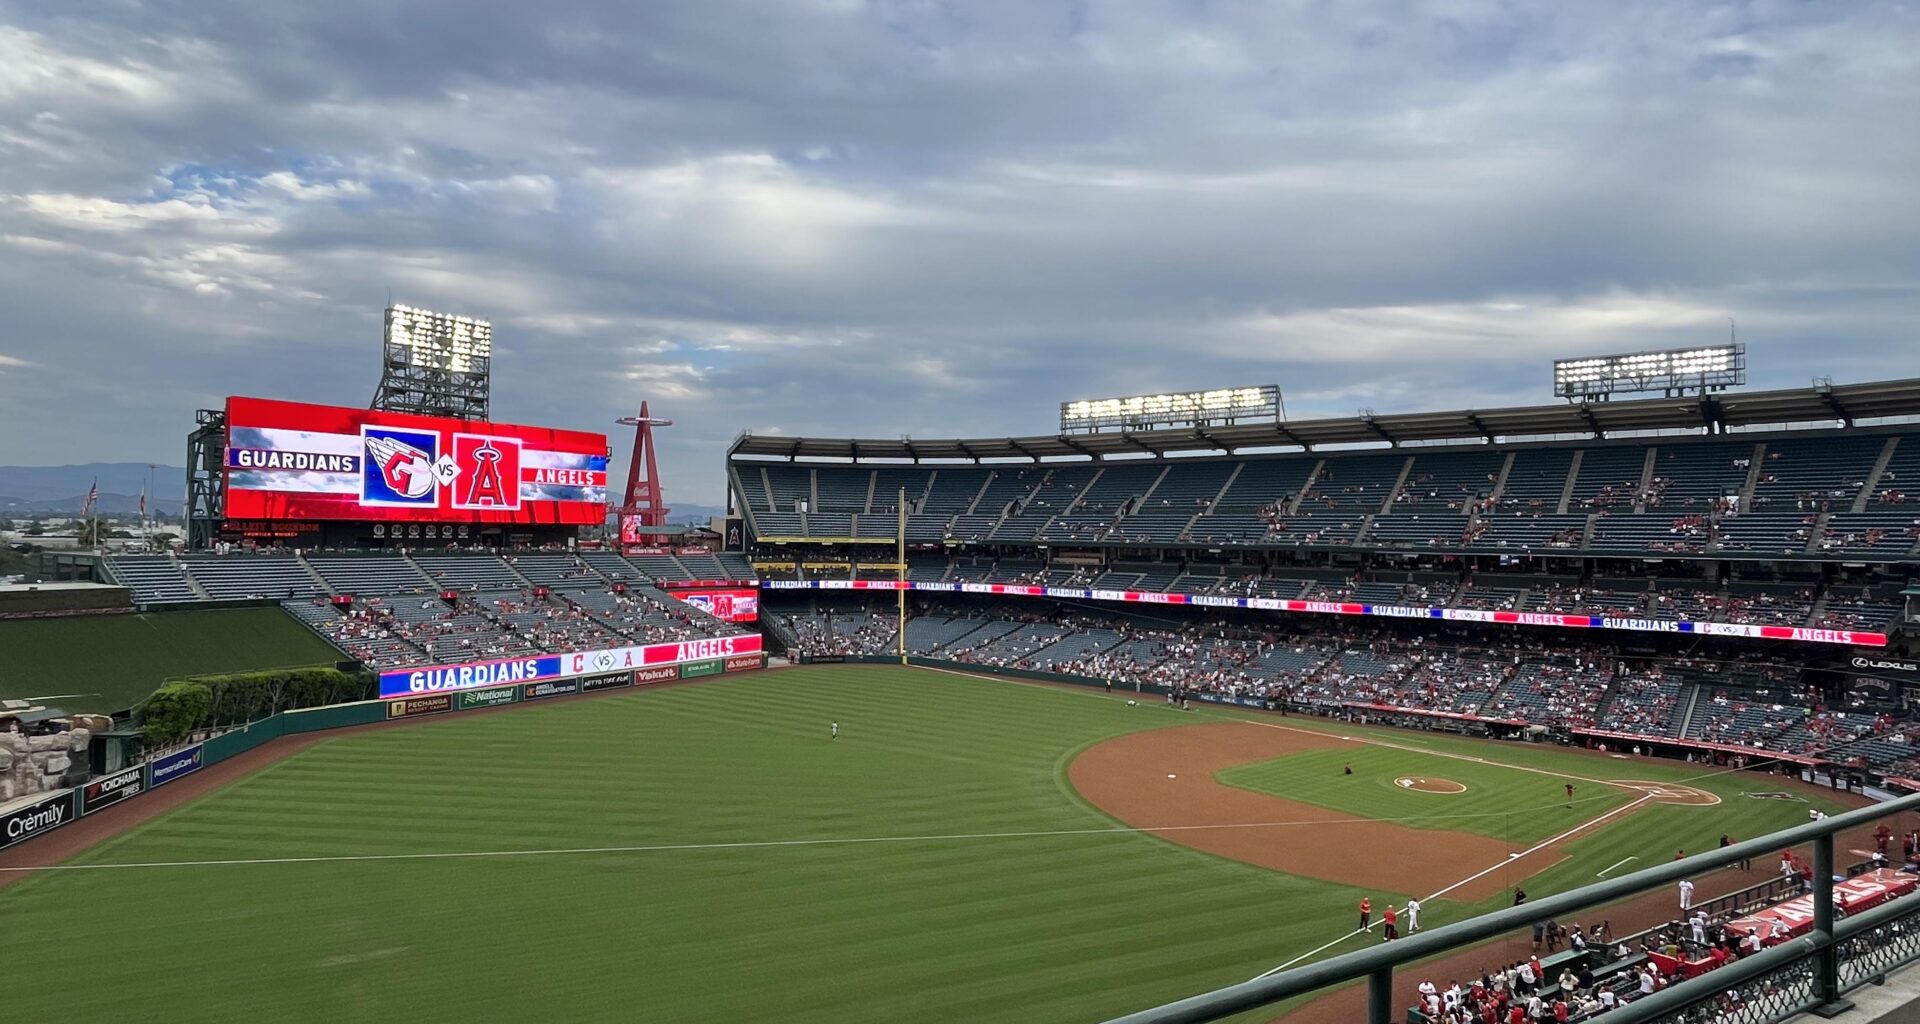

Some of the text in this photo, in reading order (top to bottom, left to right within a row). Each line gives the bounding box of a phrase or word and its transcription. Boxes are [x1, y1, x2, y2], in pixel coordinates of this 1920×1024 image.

[238, 450, 353, 472] GUARDIANS
[438, 464, 453, 476] VS
[535, 469, 594, 485] ANGELS
[867, 581, 895, 589] ANGELS
[916, 582, 955, 591] GUARDIANS
[1004, 585, 1028, 595] ANGELS
[1047, 588, 1086, 598] GUARDIANS
[1191, 596, 1238, 607] GUARDIANS
[1306, 601, 1342, 612] ANGELS
[1372, 606, 1431, 618] GUARDIANS
[1450, 610, 1456, 619] C
[1517, 614, 1564, 625] ANGELS
[1602, 618, 1678, 632] GUARDIANS
[1703, 624, 1711, 633] C
[1743, 626, 1750, 637] A
[1792, 627, 1852, 644] ANGELS
[409, 639, 734, 692] GUARDIANS C VS A ANGELS
[1870, 661, 1917, 671] LEXUS
[638, 669, 676, 680] Yakult
[476, 688, 513, 701] National
[408, 698, 448, 708] PECHANGA
[154, 759, 192, 778] MemorialCare
[100, 770, 140, 792] YOKOHAMA
[121, 783, 140, 797] TIRES
[7, 804, 65, 837] Crèmily
